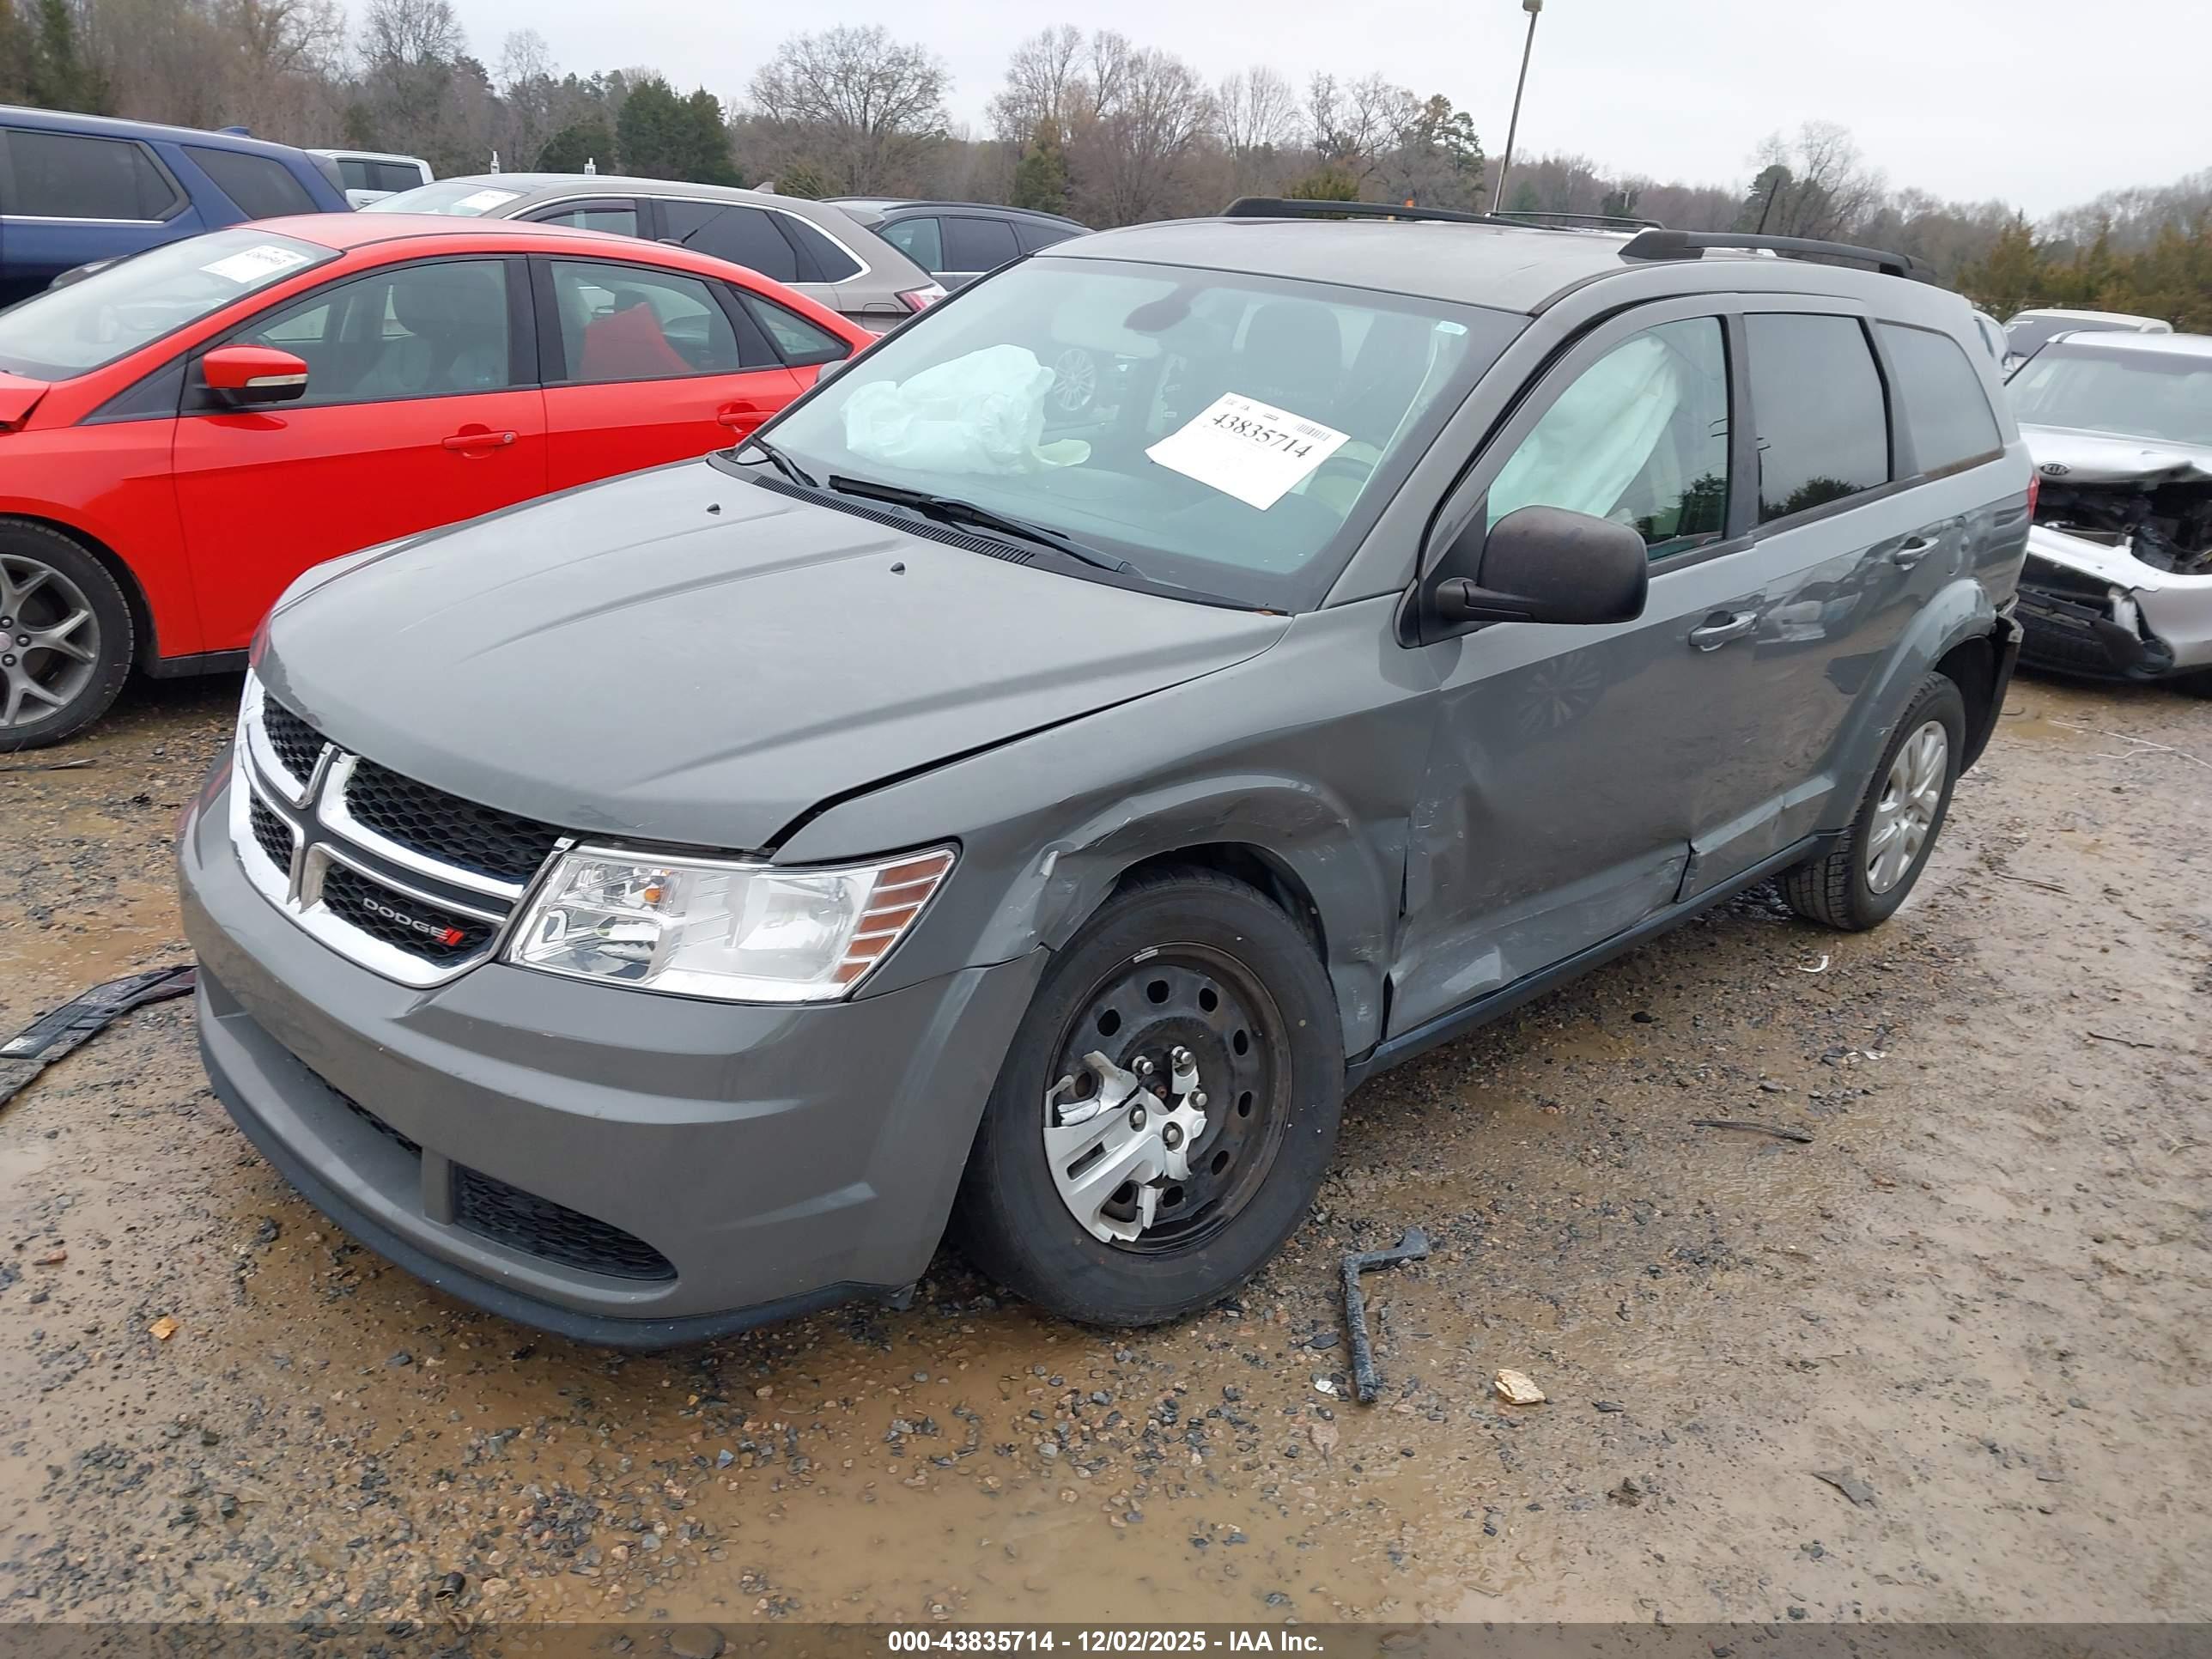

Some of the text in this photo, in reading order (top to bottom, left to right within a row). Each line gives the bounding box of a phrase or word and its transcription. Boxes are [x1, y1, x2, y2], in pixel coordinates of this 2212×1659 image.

[1212, 413, 1313, 459] 43835714
[2042, 464, 2068, 476] KIA
[362, 897, 448, 940] DODGE
